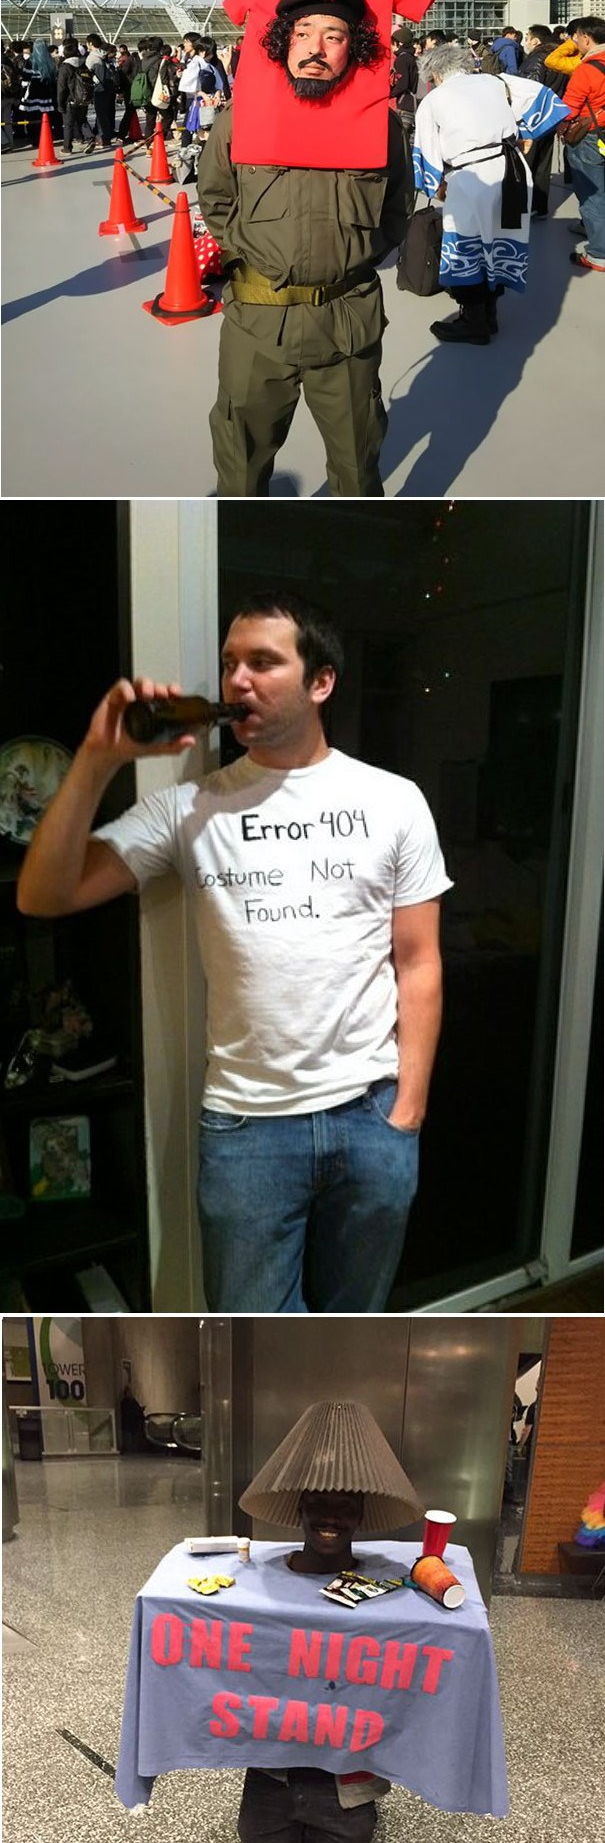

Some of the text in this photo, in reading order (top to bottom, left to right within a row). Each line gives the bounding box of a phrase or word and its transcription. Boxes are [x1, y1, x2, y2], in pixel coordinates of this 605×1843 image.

[241, 809, 369, 841] Error 404
[195, 857, 355, 889] Costume Not
[244, 895, 320, 924] Found.
[46, 1379, 84, 1400] 100
[151, 1613, 455, 1695] ONE NIGHT
[209, 1691, 385, 1753] STAND
